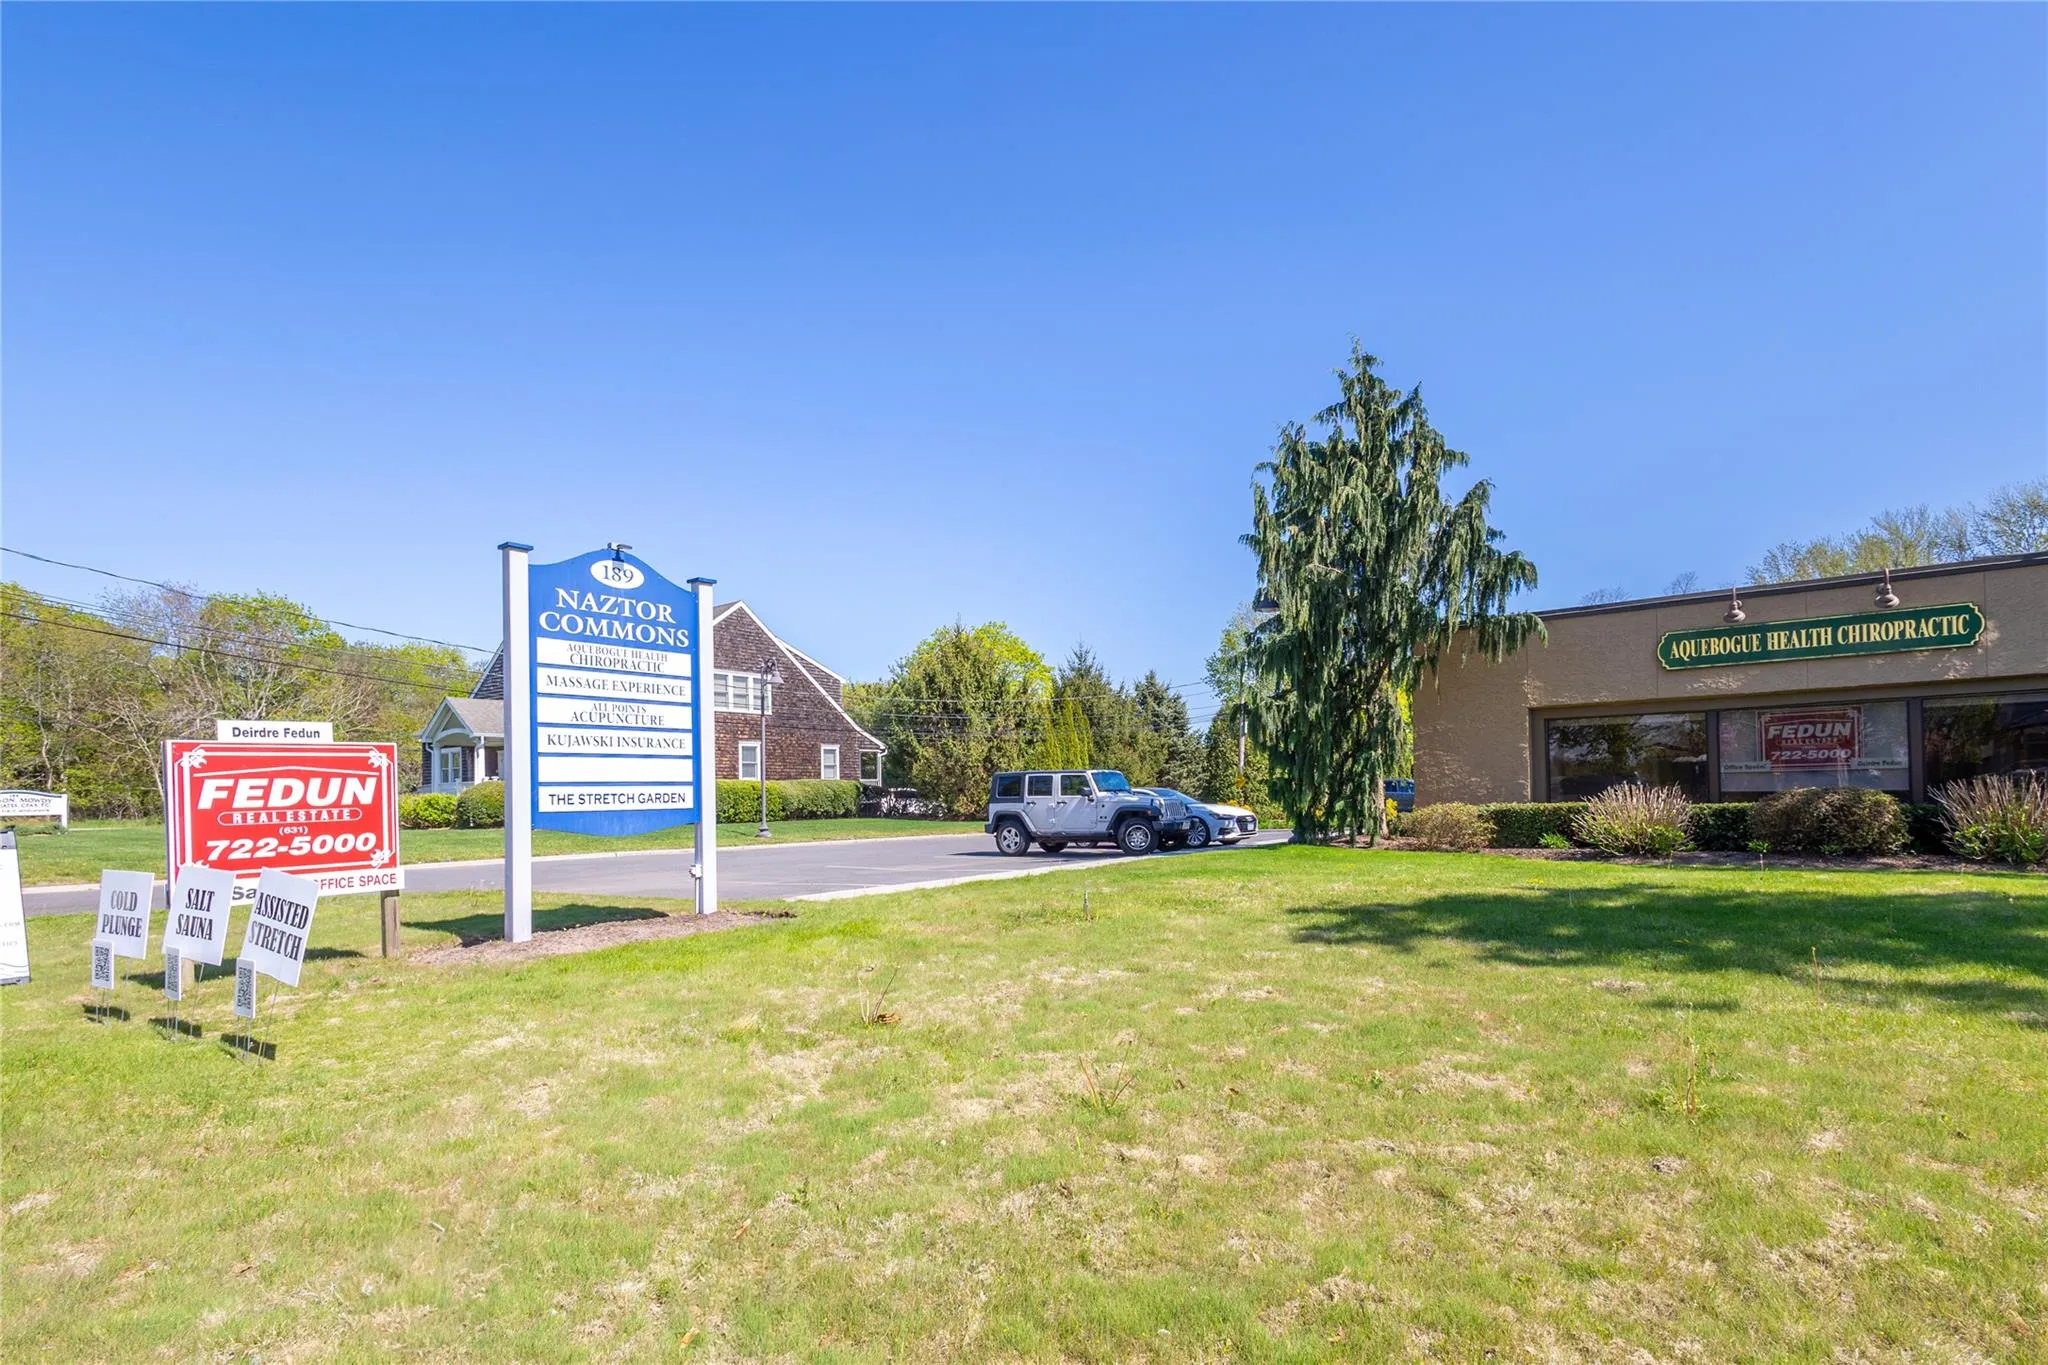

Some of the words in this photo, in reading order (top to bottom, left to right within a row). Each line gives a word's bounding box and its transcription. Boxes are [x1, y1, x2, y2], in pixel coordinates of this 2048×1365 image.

[602, 564, 634, 584] 189
[555, 587, 677, 624] NAZTOR
[538, 611, 690, 648] COMMONS
[1670, 633, 1762, 662] AQUEBOGUE
[1767, 626, 1833, 651] HEALTH
[1836, 614, 1970, 646] CHIROPRACTIC
[567, 643, 629, 658] AQUEBOGUE
[631, 650, 668, 663] HEALTH
[569, 653, 665, 673] CHIROPRACTIC
[546, 674, 610, 691] MASSAGE
[612, 680, 686, 697] EXPERIENCE
[591, 702, 608, 712] ALL
[611, 703, 647, 714] POINTS
[570, 711, 665, 726] ACUPUNCTURE
[232, 726, 279, 739] Deirdre
[283, 728, 320, 739] Fedun
[1767, 723, 1853, 739] FEDUN
[547, 734, 613, 748] KUJAWSKI
[617, 736, 686, 750] INSURANCE
[1770, 748, 1852, 760] 722-5000
[197, 777, 377, 809] FEDUN
[548, 793, 575, 806] THE
[578, 793, 635, 805] STRETCH
[638, 792, 686, 804] GARDEN
[232, 811, 281, 824] REAL
[286, 808, 350, 822] ESTATE
[279, 826, 308, 836] (631)
[205, 832, 377, 861] 722-5000
[314, 876, 354, 890] FFICE
[359, 873, 397, 887] SPACE
[110, 890, 138, 912] COLD
[185, 887, 215, 913] SALT
[253, 891, 310, 931] ASSISTED
[101, 913, 143, 938] PLUNGE
[175, 913, 214, 941] SAUNA
[248, 921, 304, 962] STRETCH
